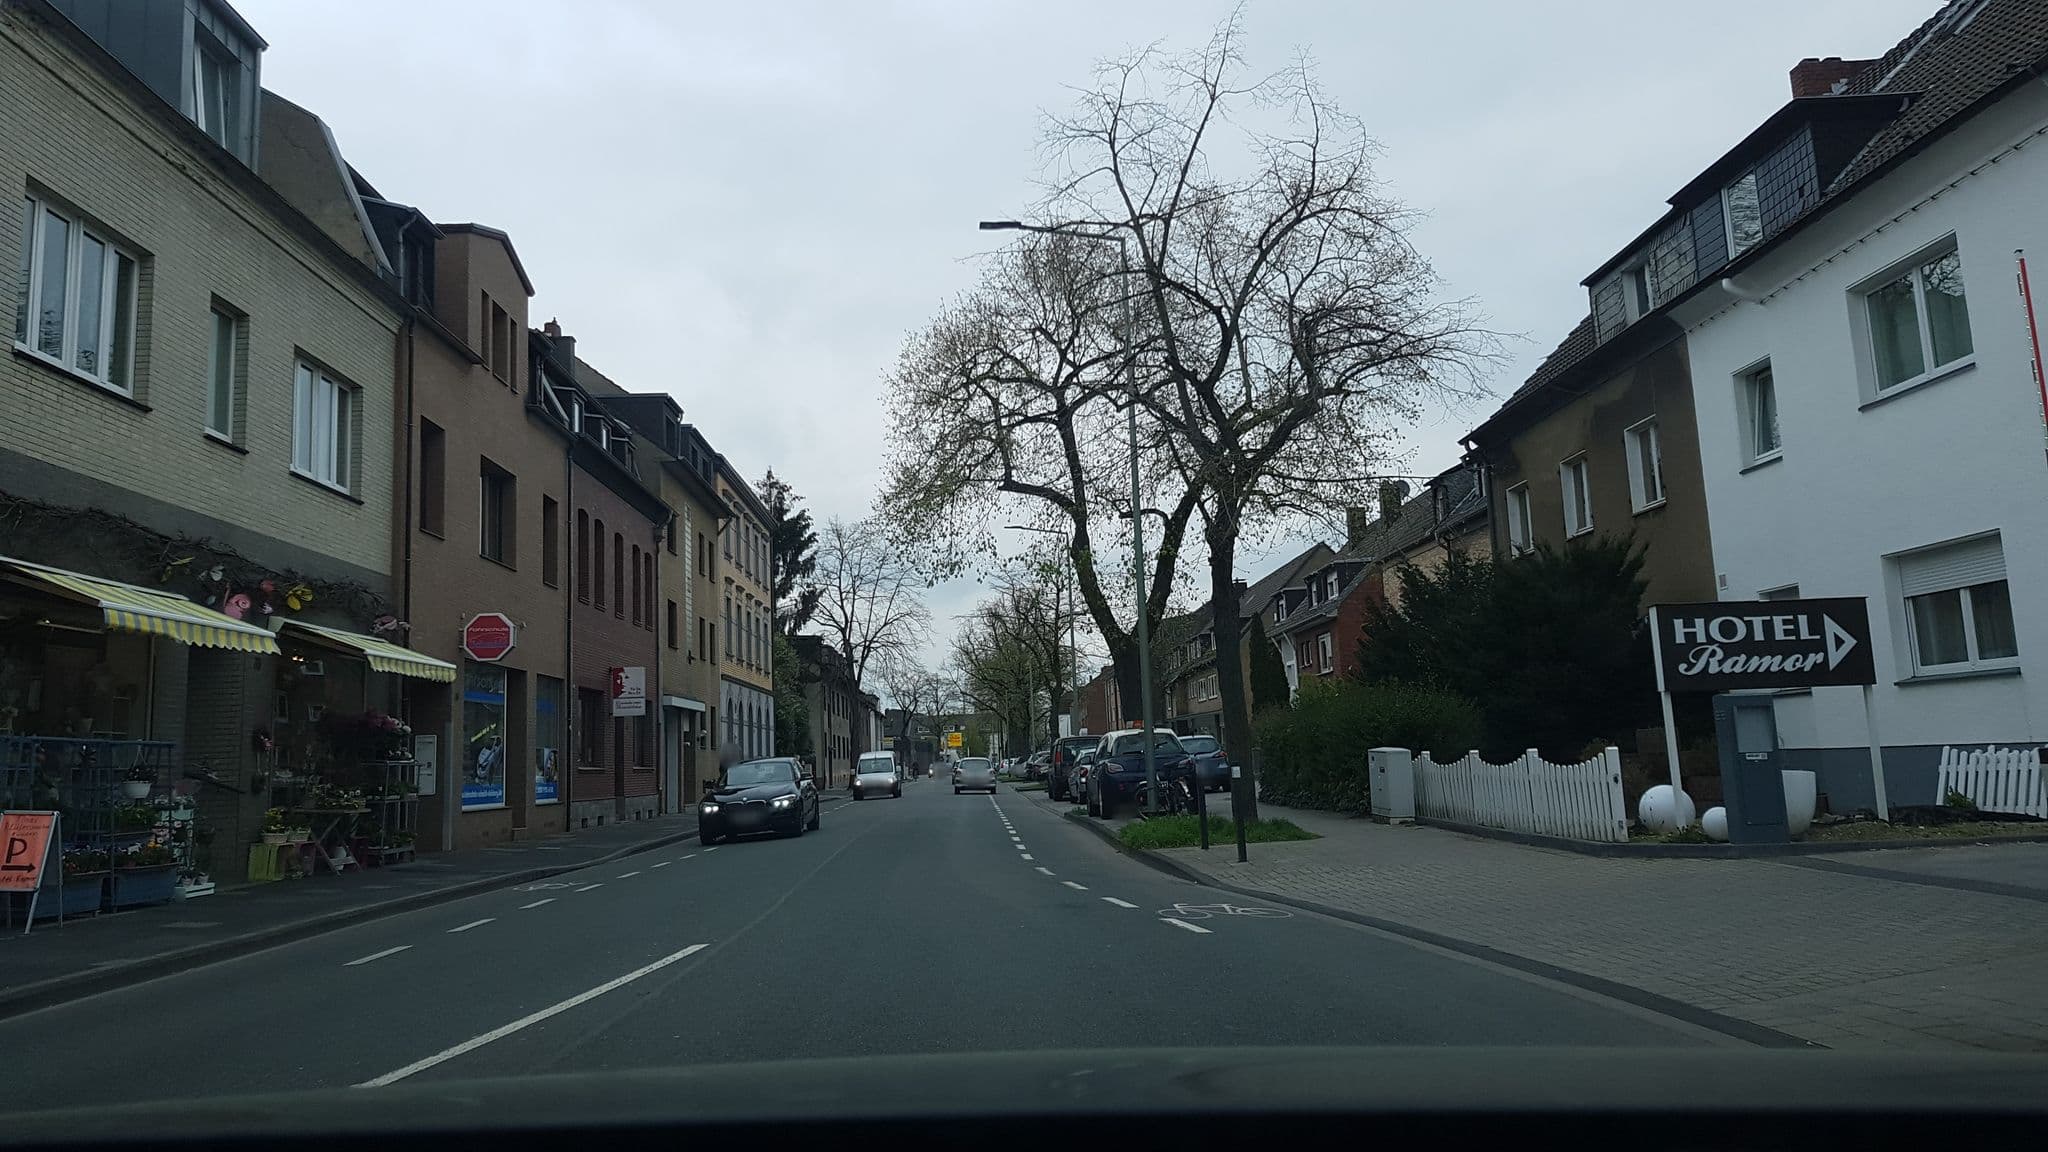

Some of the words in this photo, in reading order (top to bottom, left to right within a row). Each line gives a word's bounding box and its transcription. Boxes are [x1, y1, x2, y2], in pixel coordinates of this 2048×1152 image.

[1673, 614, 1821, 644] HOTEL
[1678, 643, 1825, 676] Ramor
[5, 837, 27, 864] P
